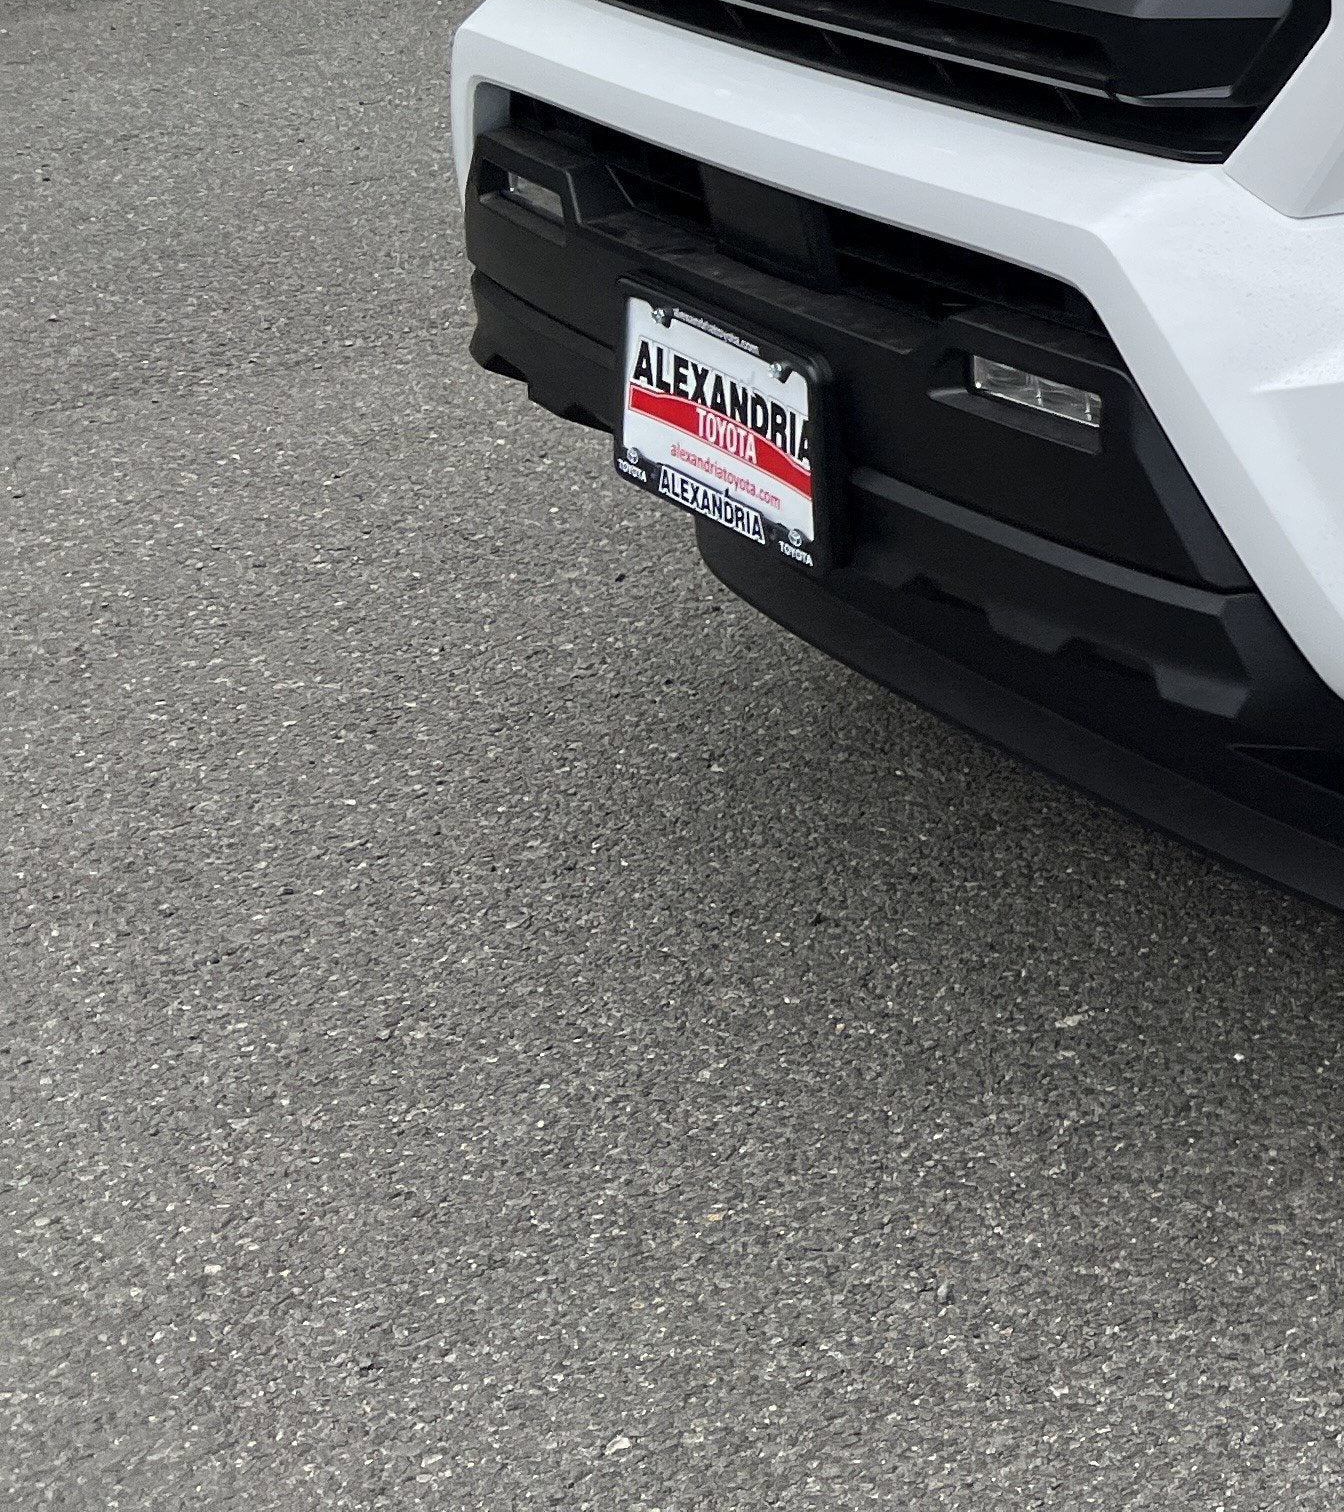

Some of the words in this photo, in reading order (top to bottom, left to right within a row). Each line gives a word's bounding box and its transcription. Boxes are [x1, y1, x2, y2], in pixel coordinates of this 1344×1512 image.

[632, 340, 812, 465] ALEXANDRIA
[697, 407, 757, 465] TOYOTA
[660, 469, 765, 544] ALEXANDRIA
[670, 443, 781, 511] alexandriatoyota.com
